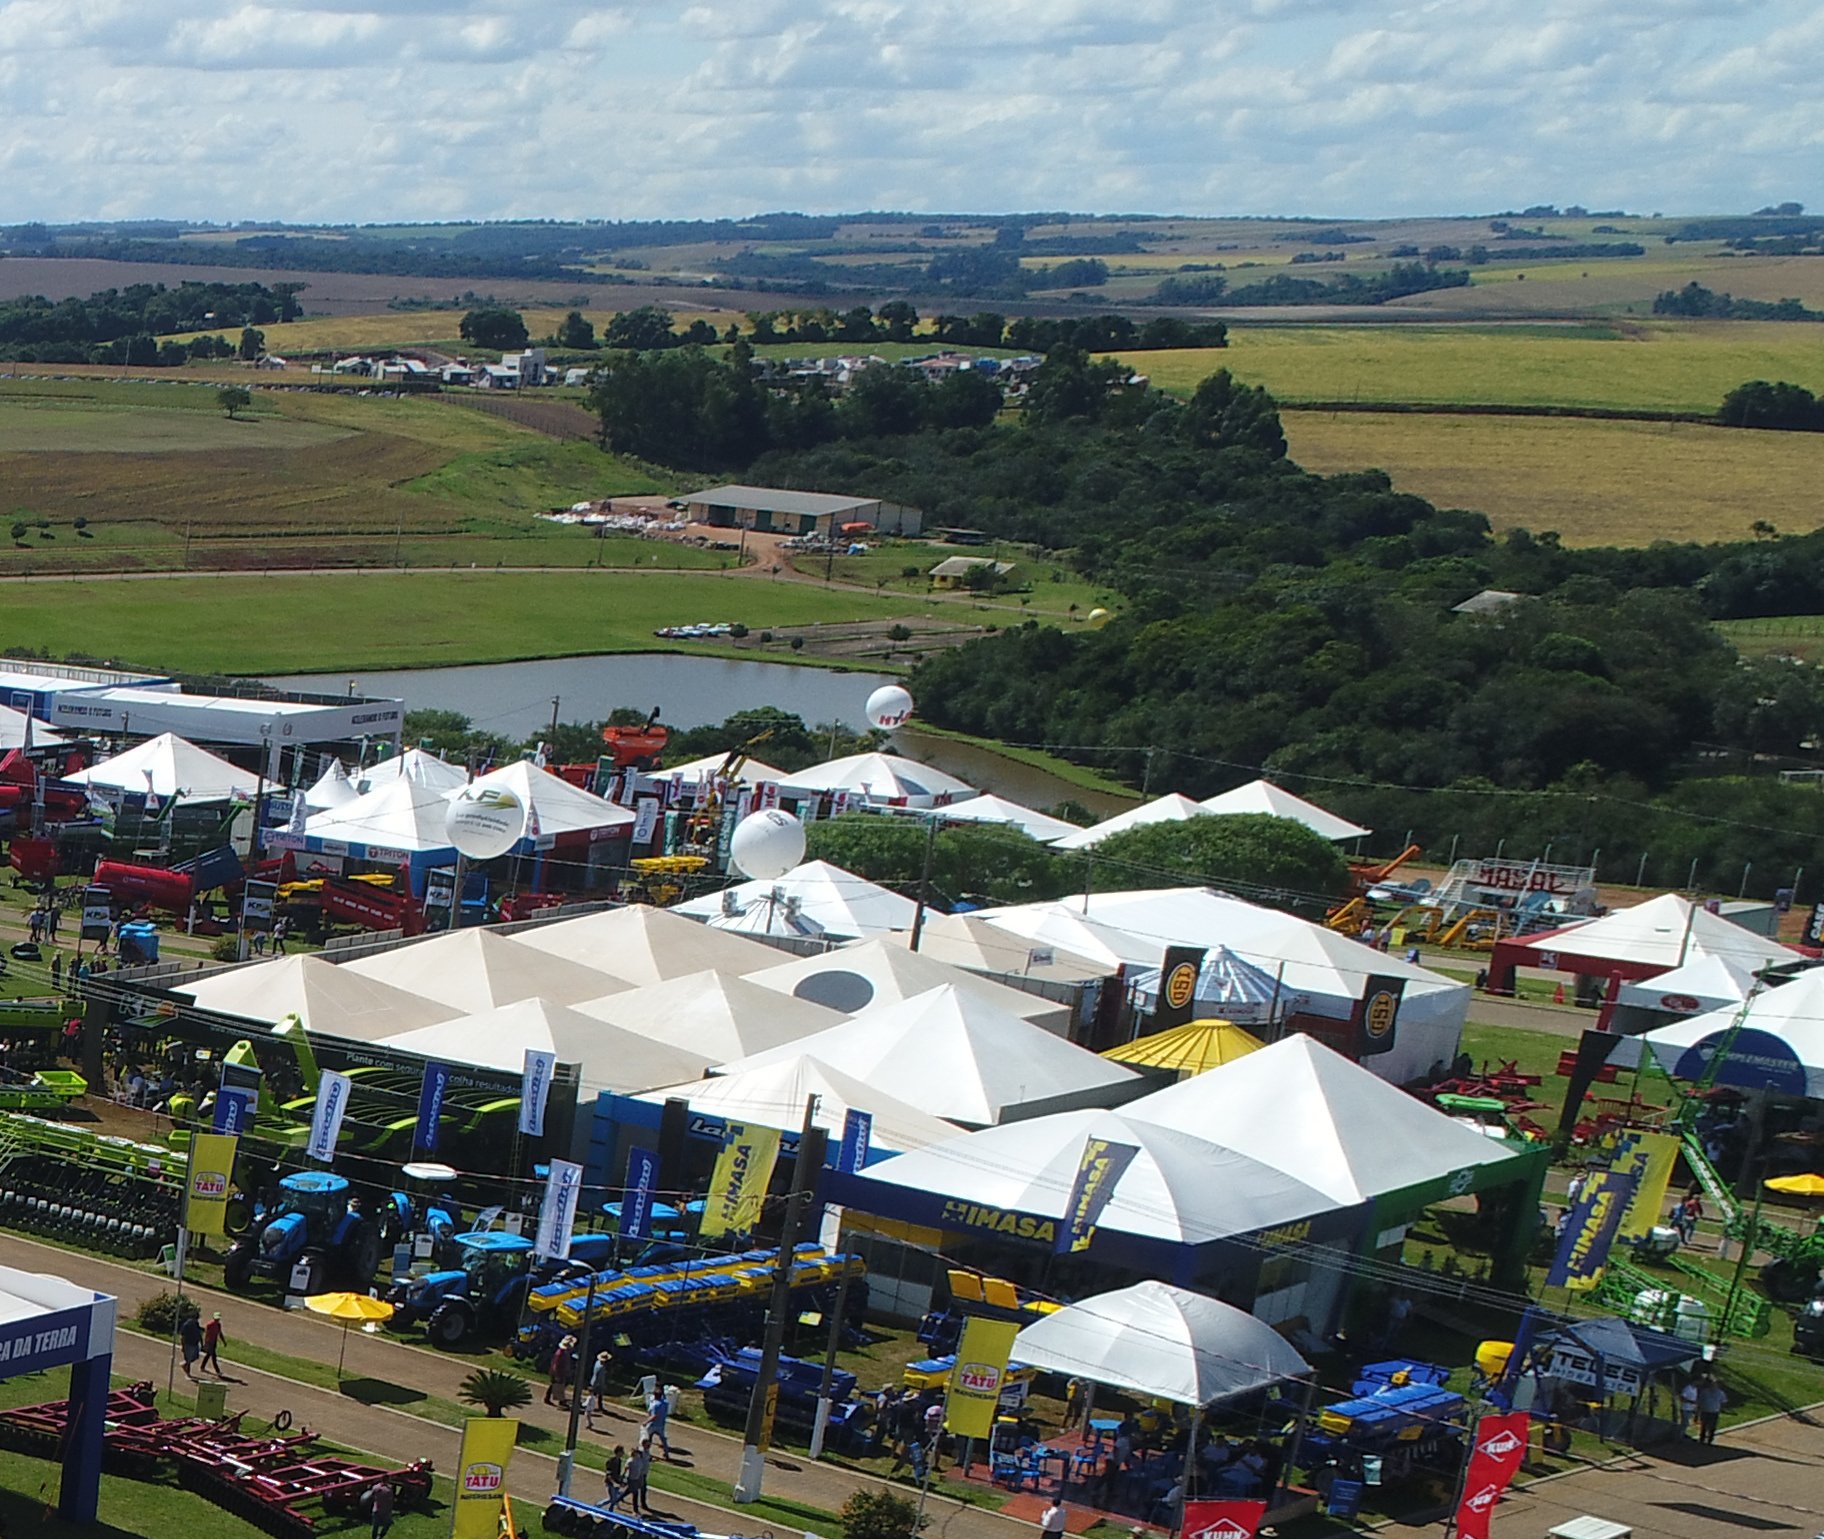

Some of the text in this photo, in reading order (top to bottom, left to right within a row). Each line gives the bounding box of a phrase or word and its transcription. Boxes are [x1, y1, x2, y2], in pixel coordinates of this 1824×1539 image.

[378, 848, 408, 860] TRITON
[346, 1051, 394, 1070] Plante com
[449, 1074, 474, 1087] colha
[195, 1181, 226, 1193] TATU
[722, 1143, 752, 1223] HIMASA
[1071, 1157, 1111, 1237] HIMASA
[942, 1200, 1056, 1243] HIMASA
[1567, 1190, 1615, 1274] HIMASA
[12, 1336, 32, 1359] DA
[34, 1325, 78, 1354] TERRA
[960, 1373, 997, 1390] TATU
[465, 1473, 499, 1489] TATU
